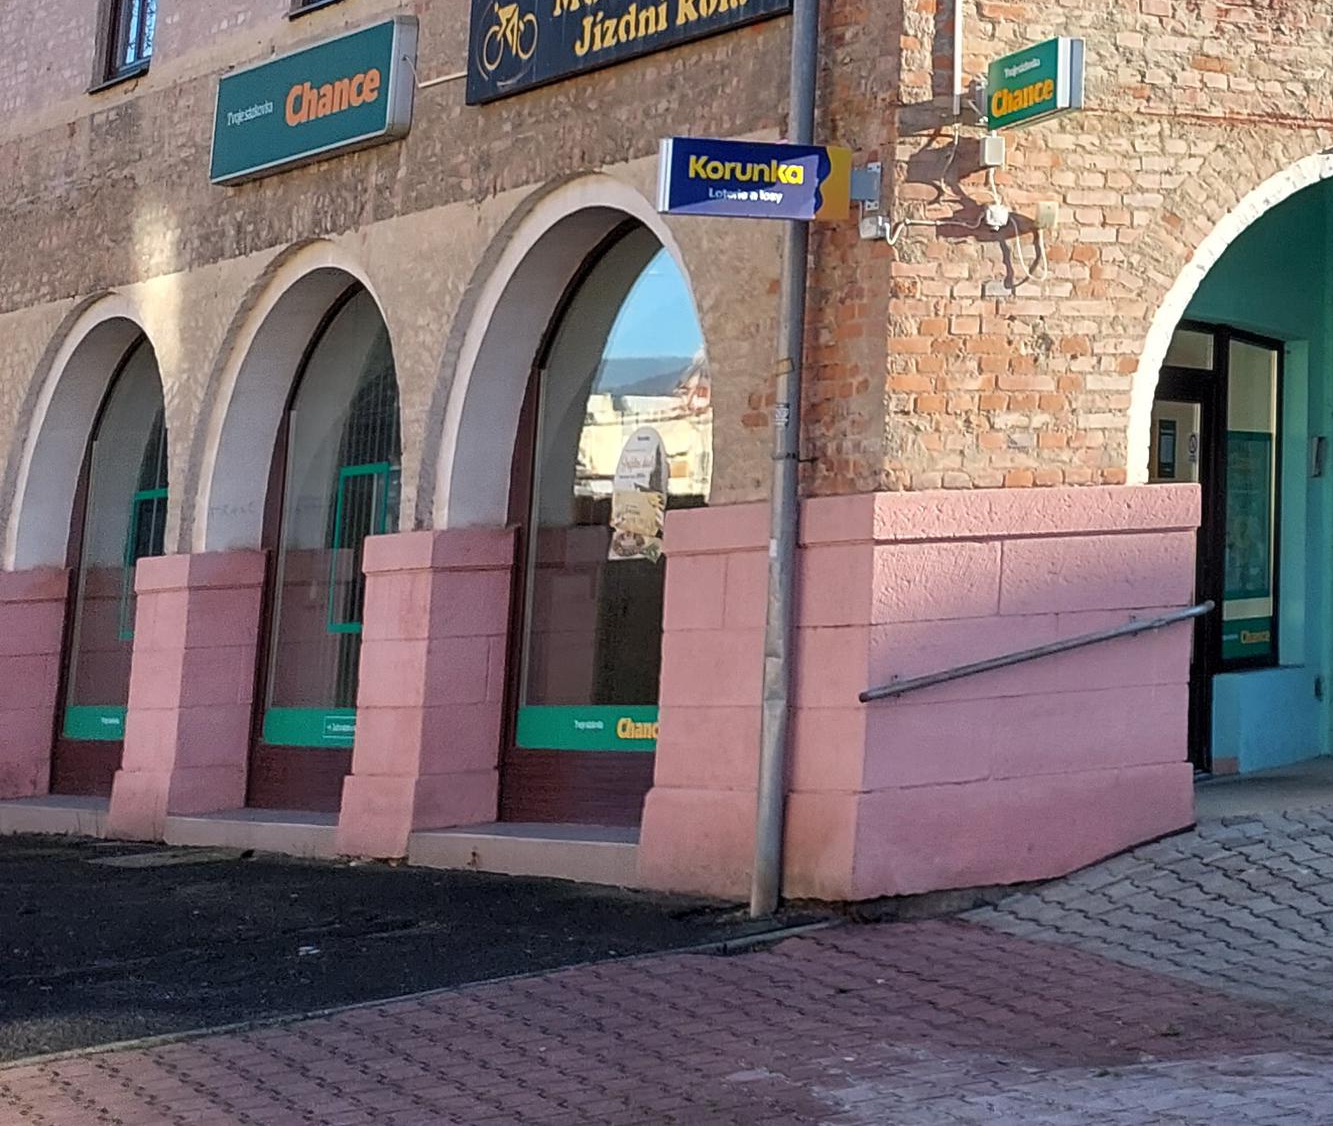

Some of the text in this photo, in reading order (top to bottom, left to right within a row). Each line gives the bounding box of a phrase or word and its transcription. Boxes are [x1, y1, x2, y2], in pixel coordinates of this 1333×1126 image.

[285, 68, 381, 127] Chance
[991, 79, 1054, 118] Chance
[688, 154, 805, 185] Korunka
